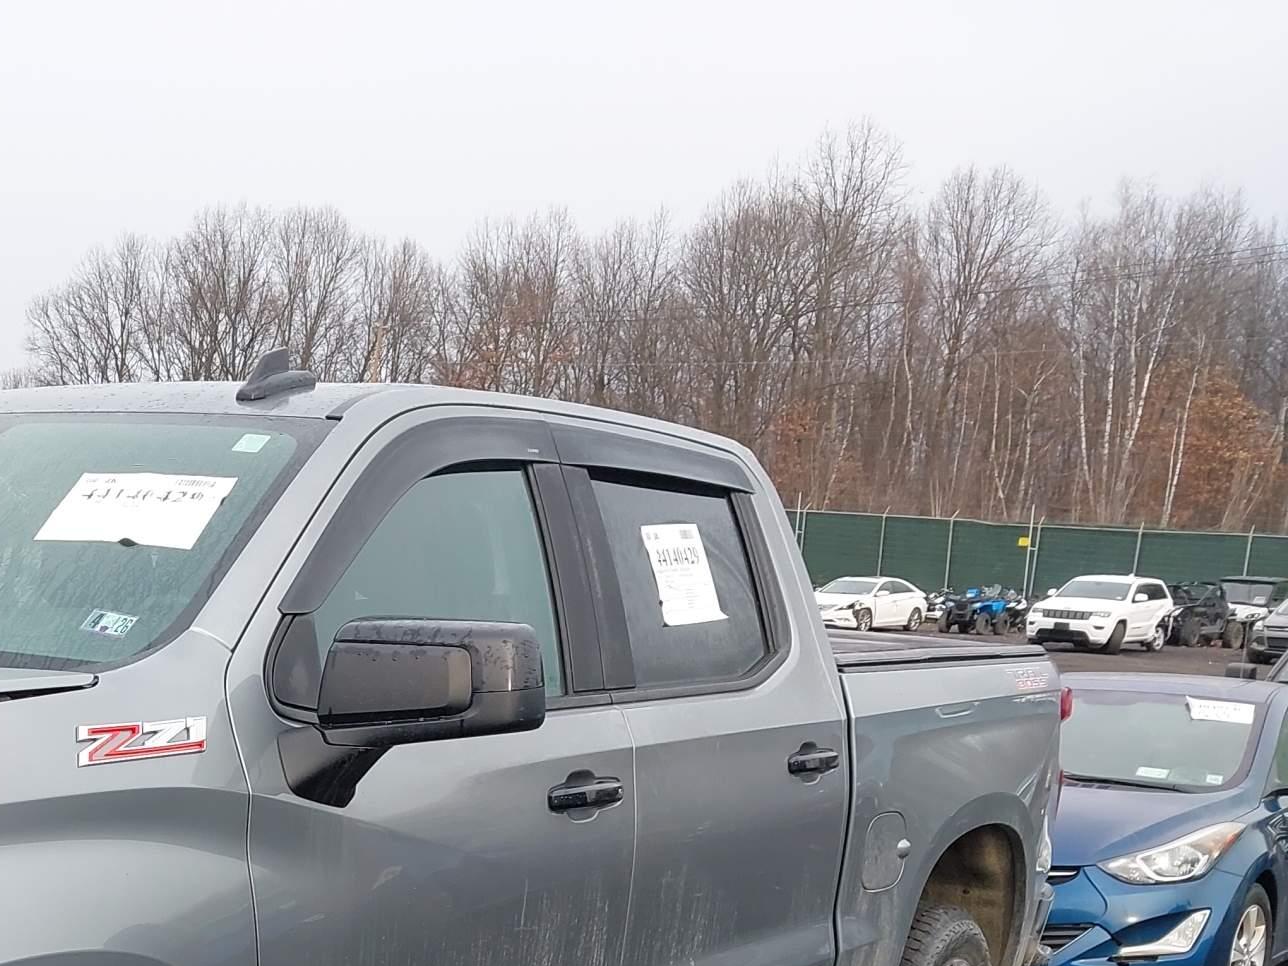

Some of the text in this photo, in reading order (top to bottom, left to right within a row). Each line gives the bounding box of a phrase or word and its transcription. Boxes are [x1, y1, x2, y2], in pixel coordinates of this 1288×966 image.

[655, 546, 700, 567] 44140429
[89, 613, 134, 634] 4 26
[75, 716, 207, 768] Z71
